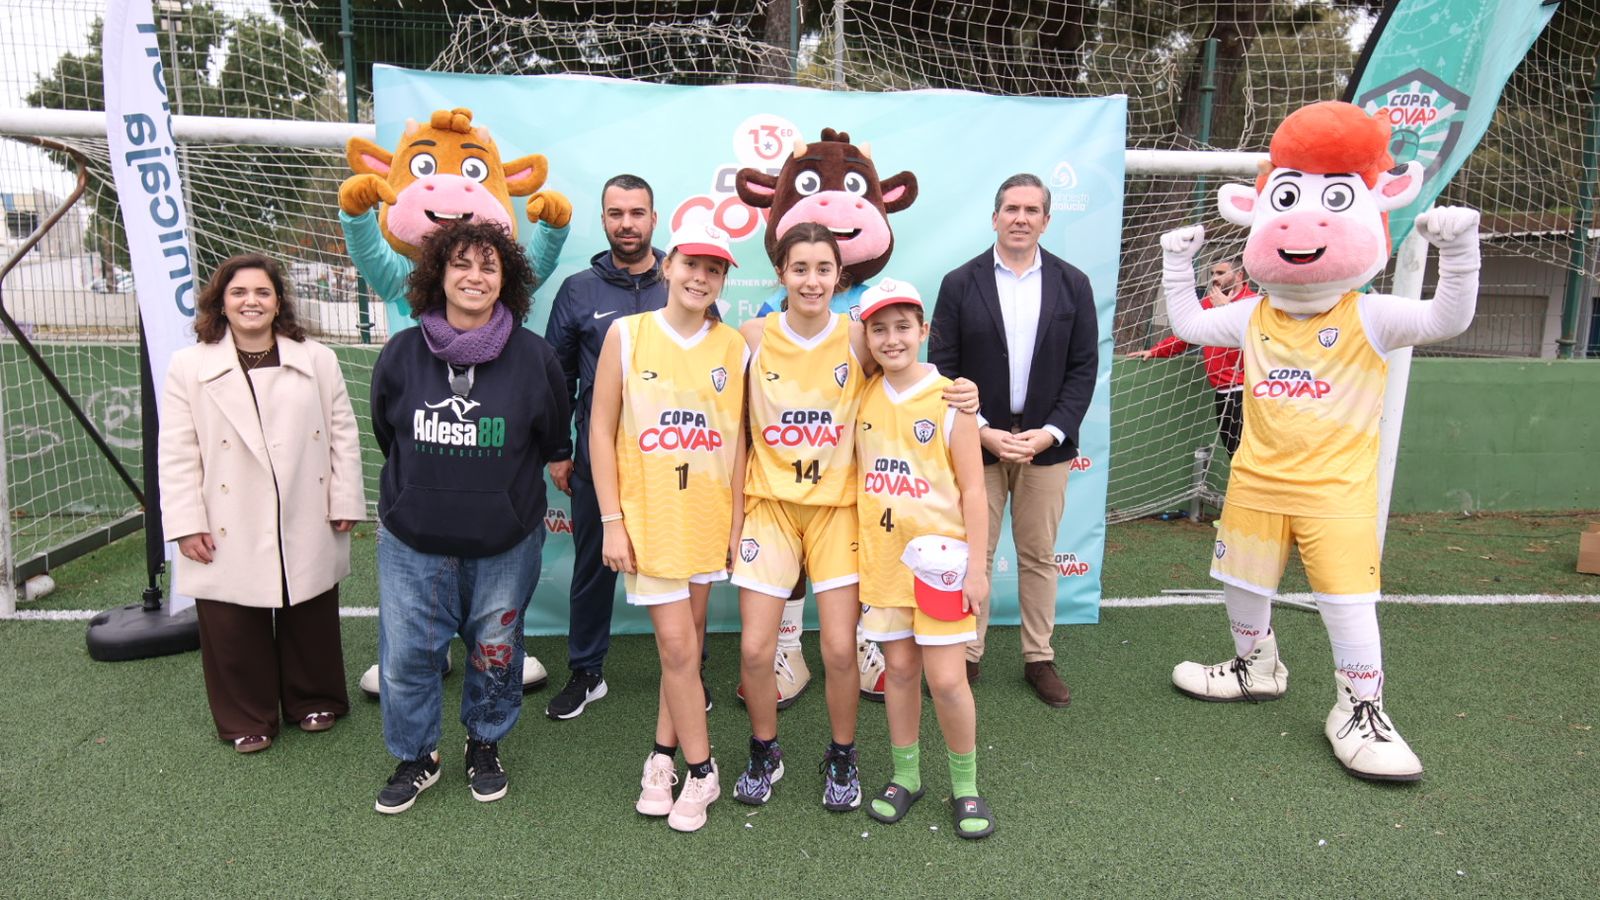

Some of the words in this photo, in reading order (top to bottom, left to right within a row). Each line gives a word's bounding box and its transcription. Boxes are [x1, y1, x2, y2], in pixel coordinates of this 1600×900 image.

[1389, 94, 1431, 108] COPA
[1385, 107, 1437, 126] OVAP
[1268, 369, 1312, 380] COPA
[1252, 380, 1331, 398] COVAP
[660, 410, 706, 428] COPA
[781, 410, 832, 424] COPA
[639, 426, 722, 452] COVAP
[792, 459, 822, 484] 14
[875, 458, 911, 475] COPA
[675, 463, 689, 490] 1
[864, 472, 930, 498] COVAP
[548, 509, 566, 519] PA
[880, 507, 894, 532] 4
[1055, 554, 1077, 563] OPA
[1056, 563, 1089, 576] VAP
